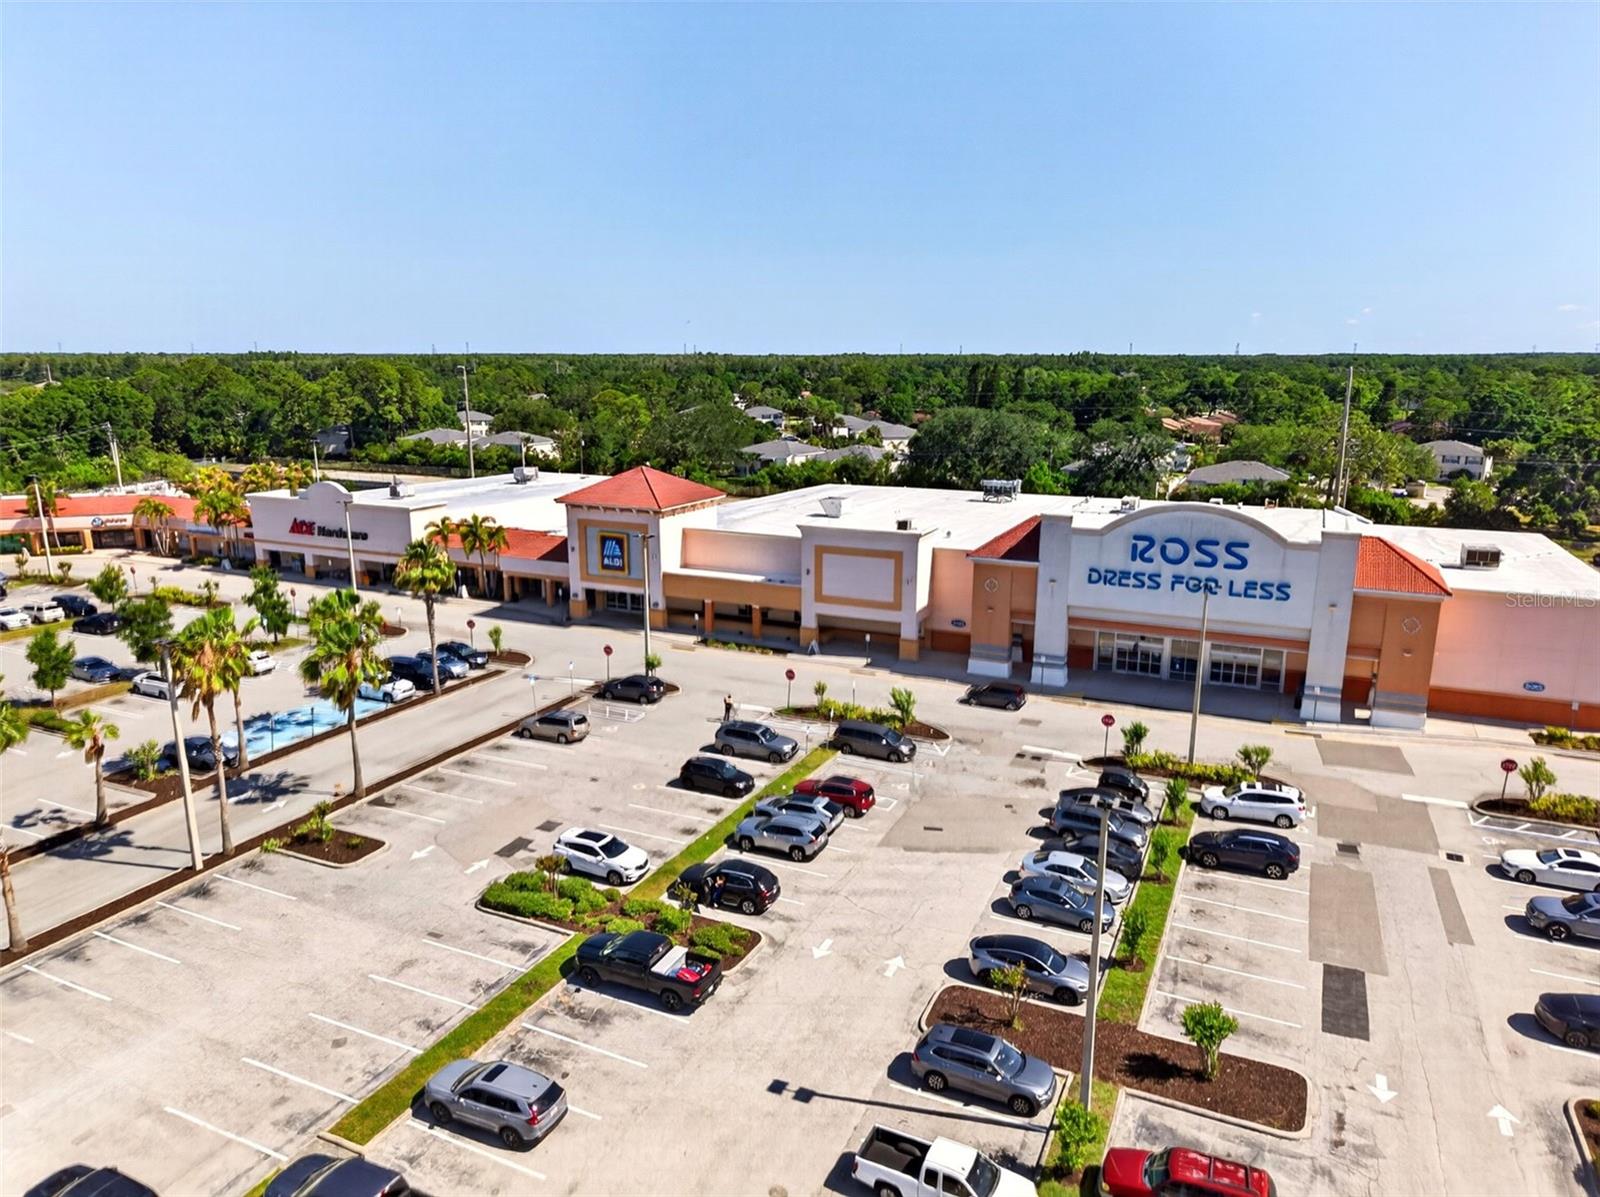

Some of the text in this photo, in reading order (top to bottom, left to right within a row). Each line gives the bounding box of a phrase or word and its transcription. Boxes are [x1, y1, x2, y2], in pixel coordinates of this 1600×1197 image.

[603, 557, 623, 567] ALDI
[1131, 534, 1250, 570] ROSS
[1088, 567, 1292, 601] DRESS FOR LESS
